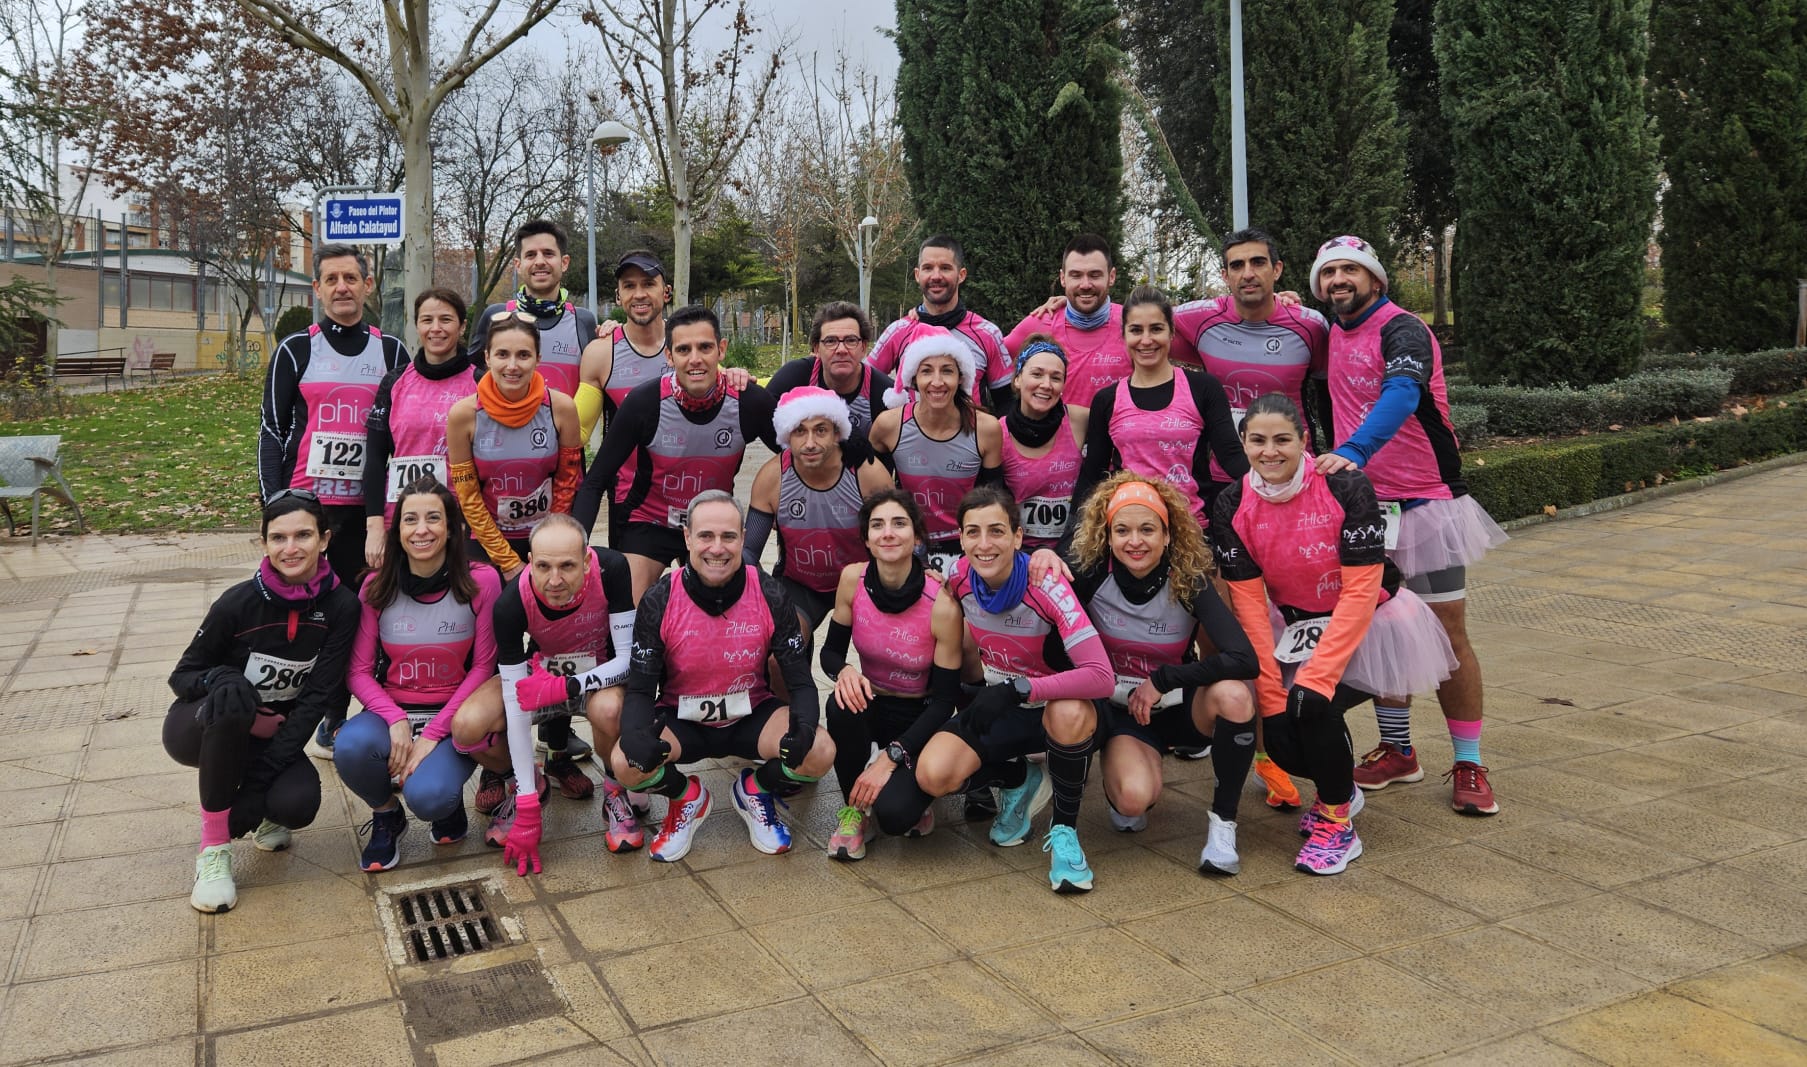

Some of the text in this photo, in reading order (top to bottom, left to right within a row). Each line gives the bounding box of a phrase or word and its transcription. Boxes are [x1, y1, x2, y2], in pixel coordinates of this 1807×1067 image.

[348, 205, 398, 216] Paseo del Pintor
[330, 220, 398, 236] Alfredo Calatayud
[322, 441, 362, 466] 122
[509, 490, 548, 520] 386
[1024, 502, 1066, 526] 709
[726, 621, 760, 635] PHIGP
[254, 664, 311, 690] 286
[547, 660, 576, 676] 58
[700, 698, 728, 723] 21
